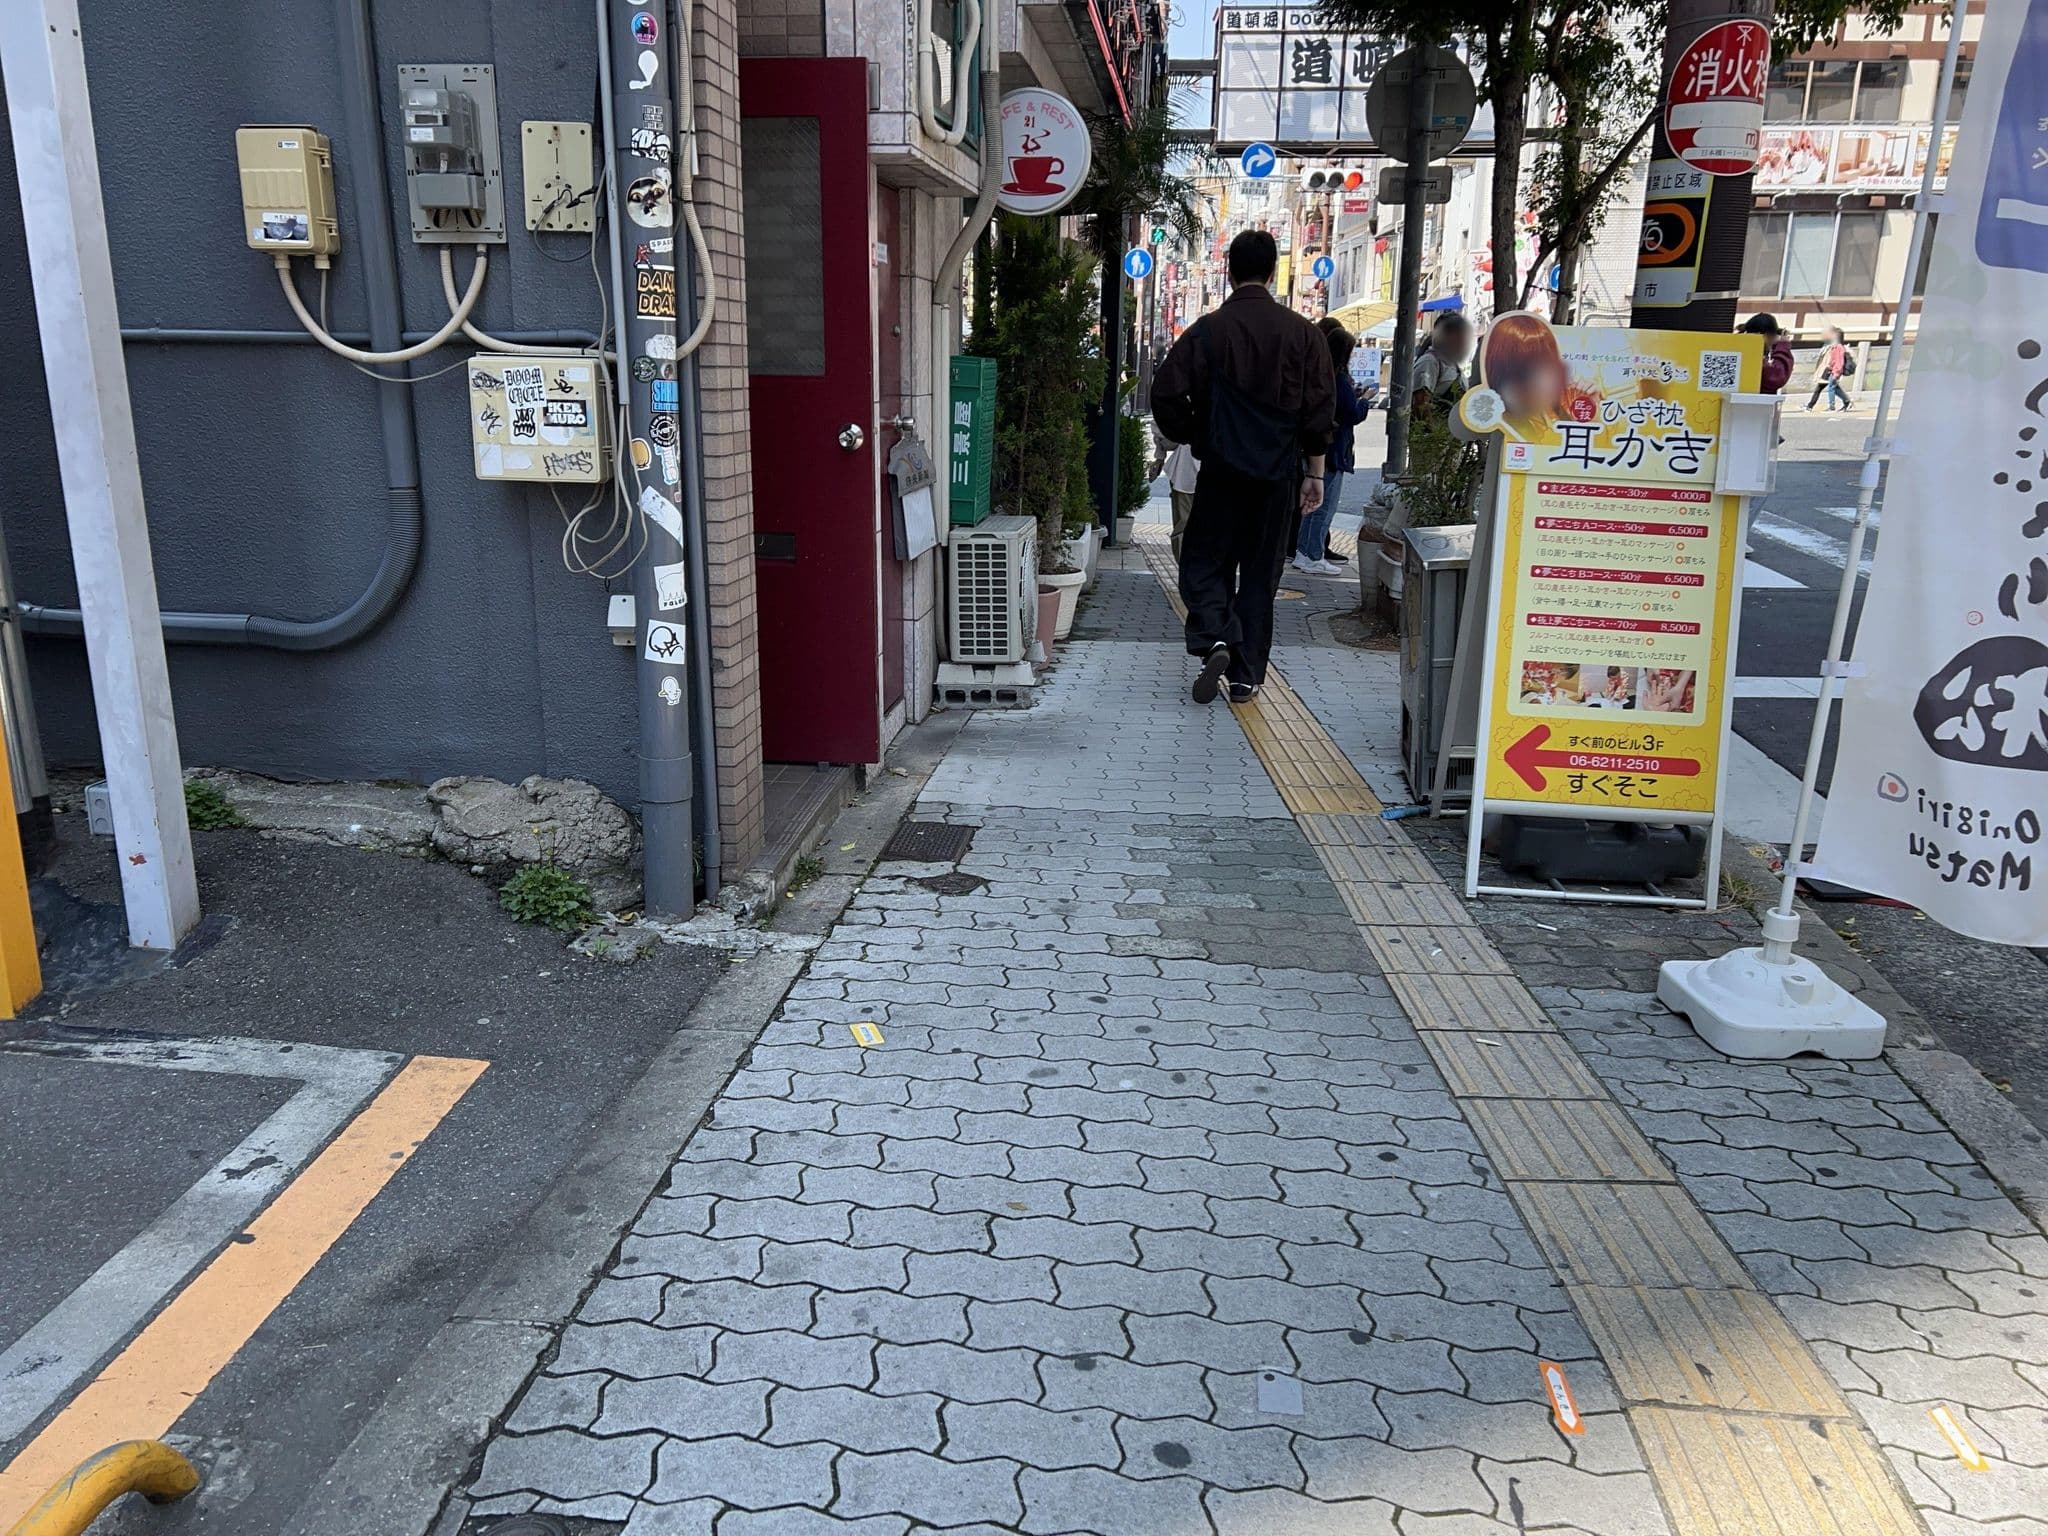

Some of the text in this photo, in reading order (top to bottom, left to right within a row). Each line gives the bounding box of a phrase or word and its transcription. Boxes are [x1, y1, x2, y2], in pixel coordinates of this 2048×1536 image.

[1226, 10, 1279, 29] 道頓堀
[1023, 115, 1036, 128] 21
[1040, 102, 1075, 130] REST
[504, 367, 543, 386] DOOM
[1601, 400, 1685, 427] ひざ枕
[1548, 424, 1715, 475] 耳かき
[1671, 490, 1707, 501] 4,000円
[1668, 526, 1704, 537] 6,500円
[1664, 575, 1700, 585] 6,500円
[1660, 623, 1697, 634] 8,500円
[1569, 755, 1660, 772] 06-6211-2510
[1567, 773, 1660, 798] すぐそこ
